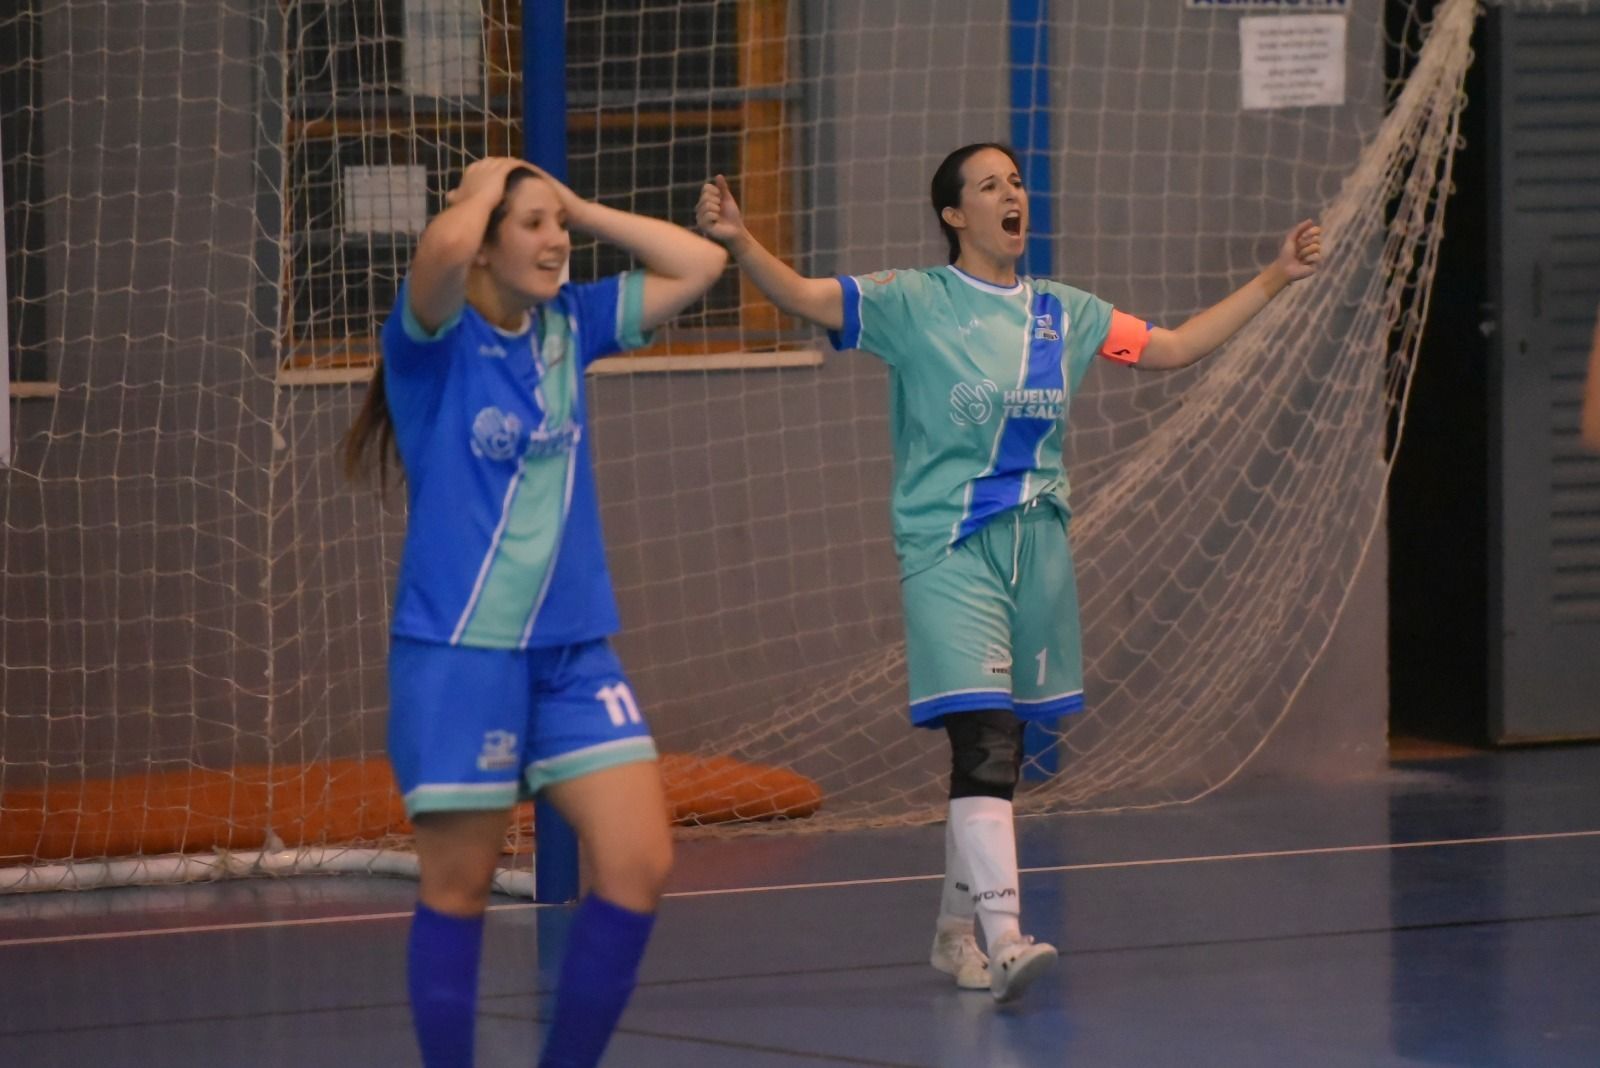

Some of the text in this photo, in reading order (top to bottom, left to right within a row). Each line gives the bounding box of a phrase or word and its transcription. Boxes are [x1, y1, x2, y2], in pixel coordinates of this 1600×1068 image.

[1003, 389, 1065, 404] HUELVA
[1035, 648, 1047, 687] 1
[595, 681, 641, 726] 11
